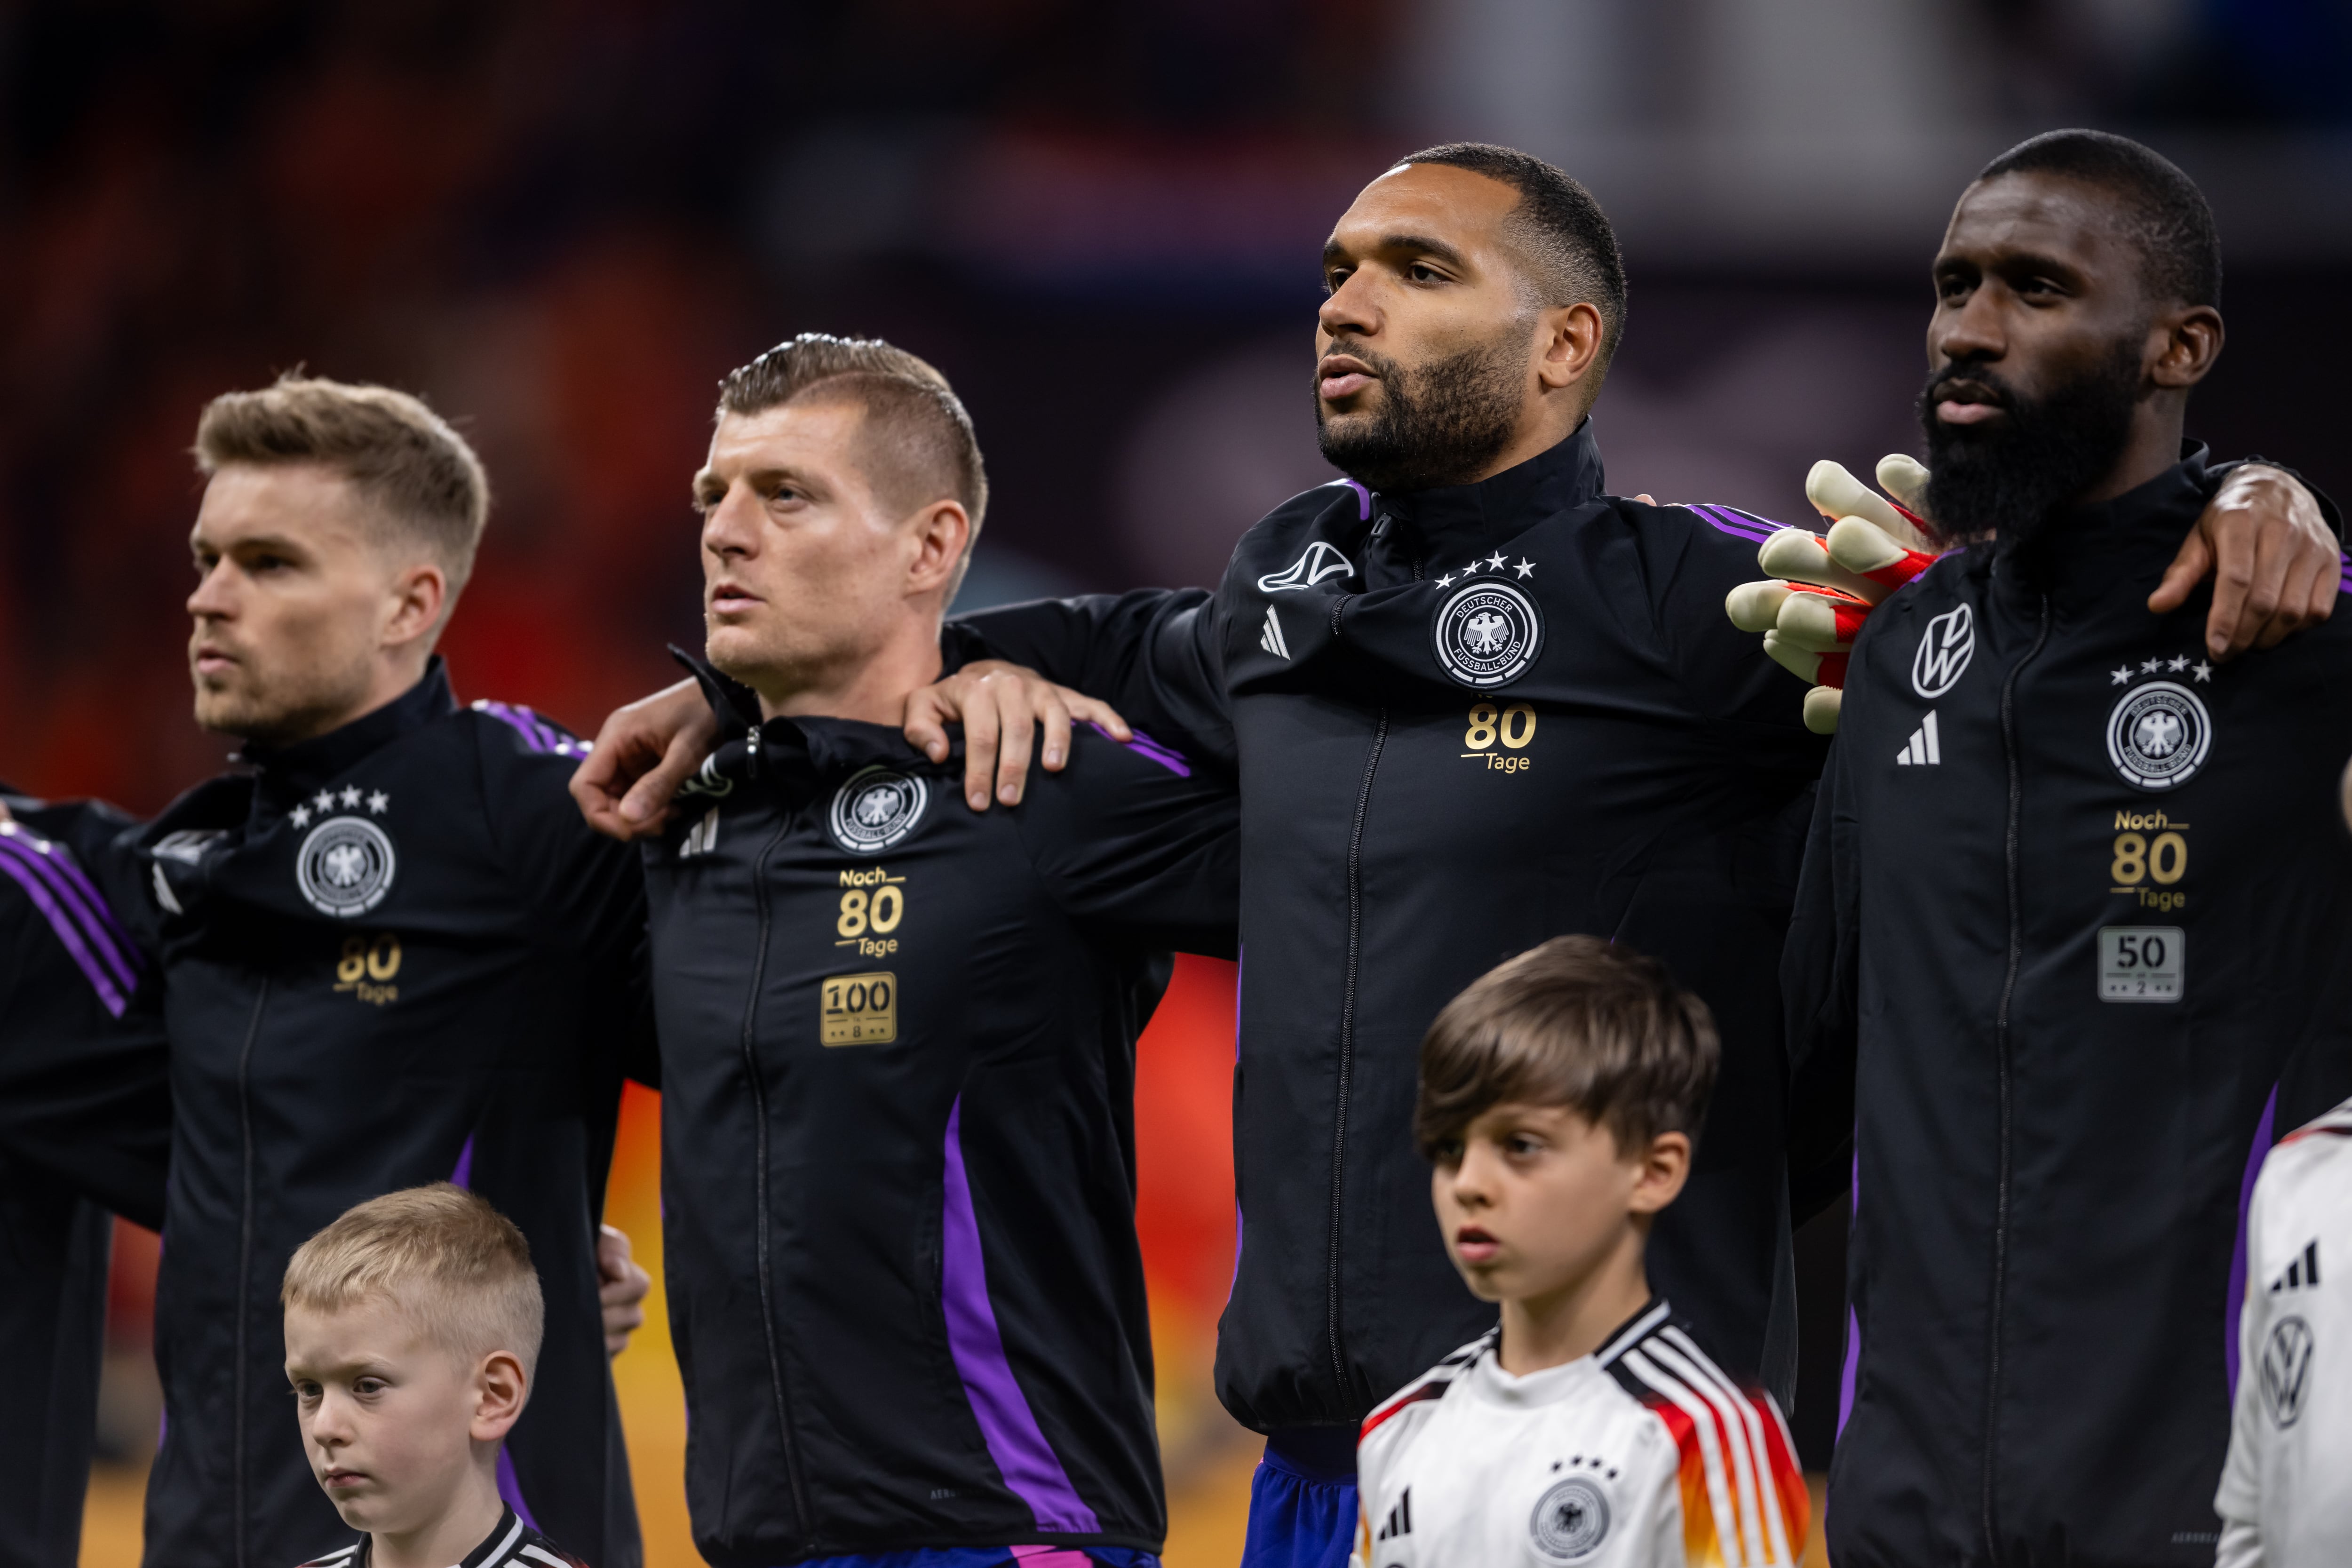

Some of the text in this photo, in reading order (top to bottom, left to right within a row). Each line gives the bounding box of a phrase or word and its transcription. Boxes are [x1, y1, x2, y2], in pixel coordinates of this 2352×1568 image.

[1456, 597, 1513, 618] DEUTSCHER
[1454, 641, 1521, 671] FUSSBALL-BUND
[1465, 702, 1536, 750] 80
[1486, 753, 1531, 774] Tage
[2114, 809, 2168, 830] Noch
[2111, 832, 2187, 885] 80
[839, 866, 887, 887] Noch
[837, 885, 904, 938] 80
[2137, 887, 2185, 912] Tage
[336, 934, 402, 983] 80
[858, 937, 898, 958] Tage
[2118, 934, 2165, 968] 50
[826, 980, 890, 1014] 100
[2137, 980, 2146, 994] 2
[853, 1026, 861, 1037] 8
